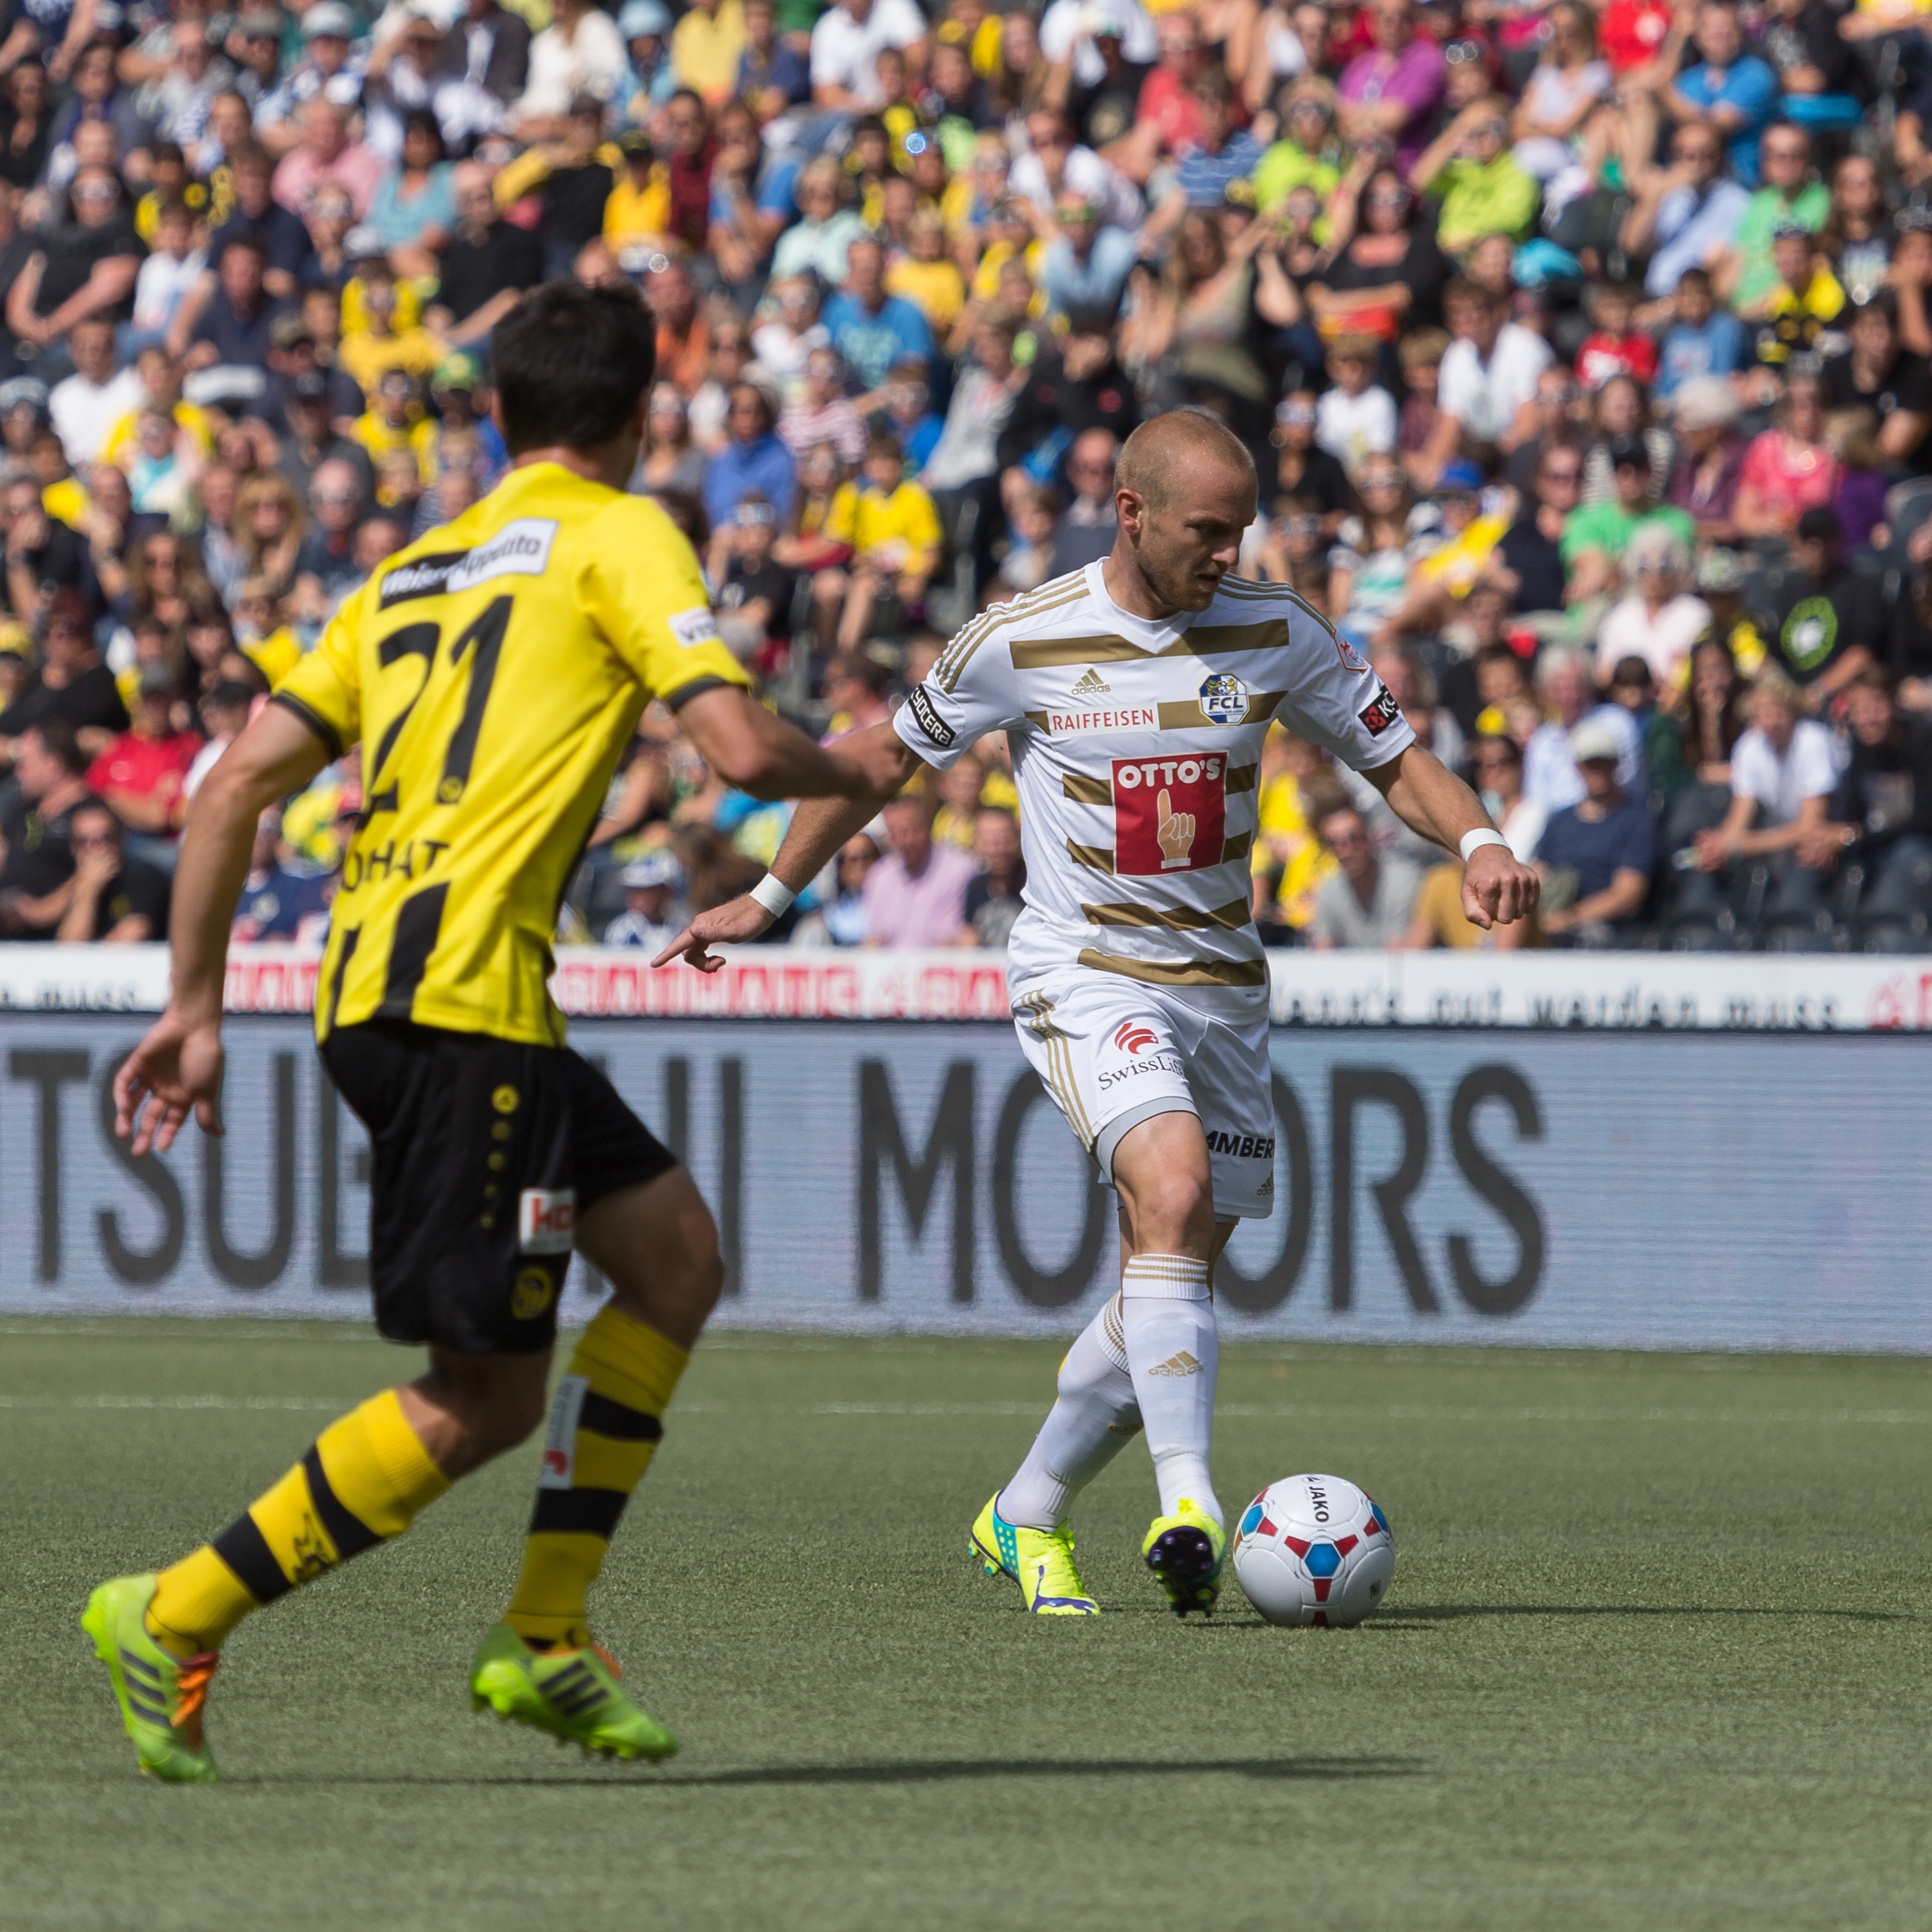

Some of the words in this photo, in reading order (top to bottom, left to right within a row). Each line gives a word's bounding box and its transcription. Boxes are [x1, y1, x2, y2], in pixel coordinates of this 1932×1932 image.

[1071, 684, 1111, 695] adidas
[354, 595, 514, 833] 21
[1209, 696, 1244, 710] FCL
[1052, 709, 1154, 731] RAIFFEISEN
[1118, 758, 1220, 789] OTTO'S
[1148, 1363, 1204, 1377] adidas
[1309, 1486, 1330, 1523] JAKO
